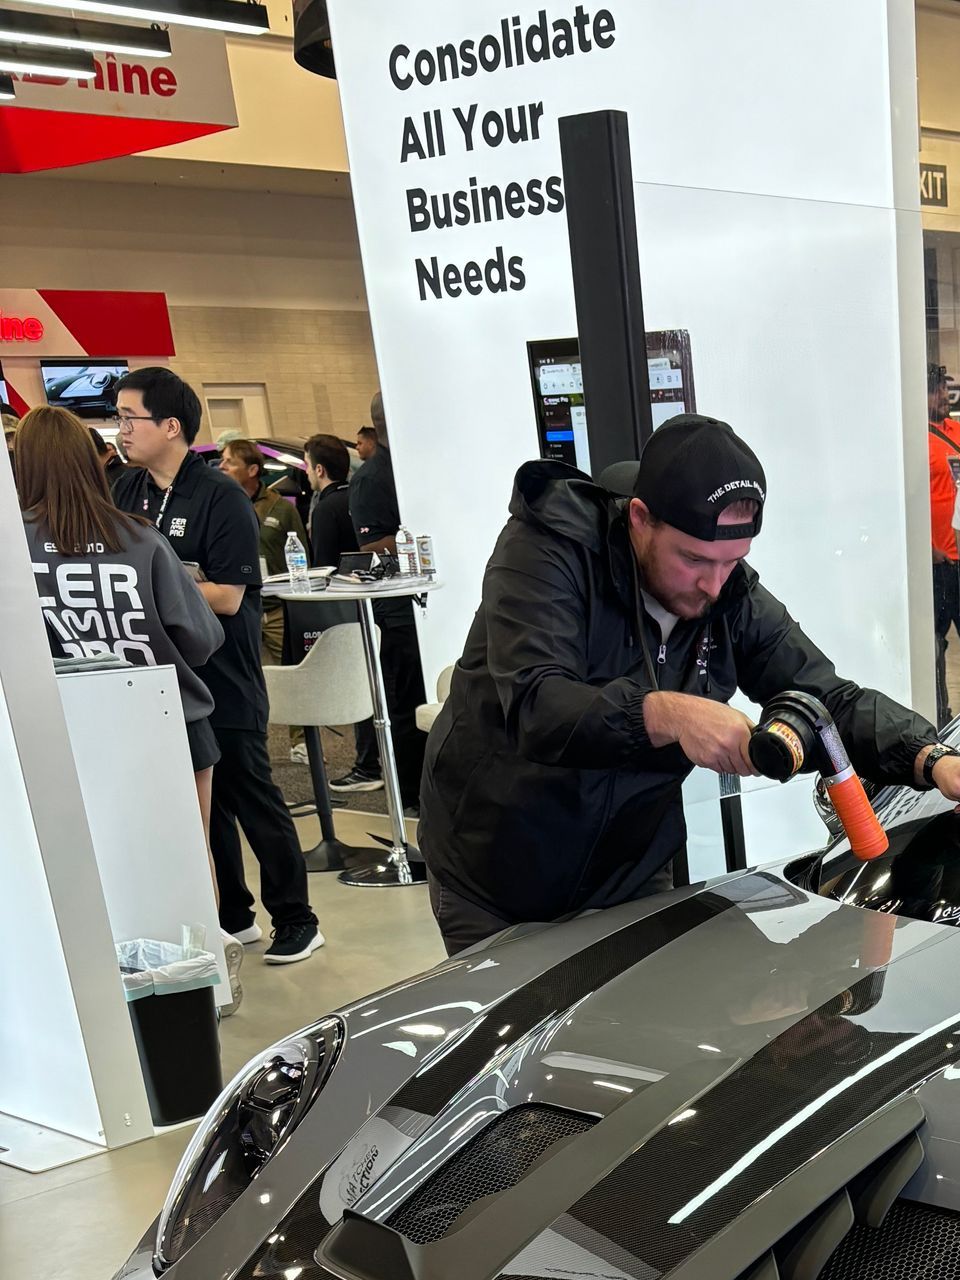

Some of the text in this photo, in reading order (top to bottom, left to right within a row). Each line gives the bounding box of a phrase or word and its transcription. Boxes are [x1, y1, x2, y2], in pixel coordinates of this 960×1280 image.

[389, 5, 616, 91] Consolidate
[400, 101, 544, 163] All Your
[406, 176, 565, 232] Business
[920, 171, 944, 200] XIT
[415, 246, 526, 301] Needs
[707, 487, 725, 503] THE
[724, 480, 753, 492] DETAIL
